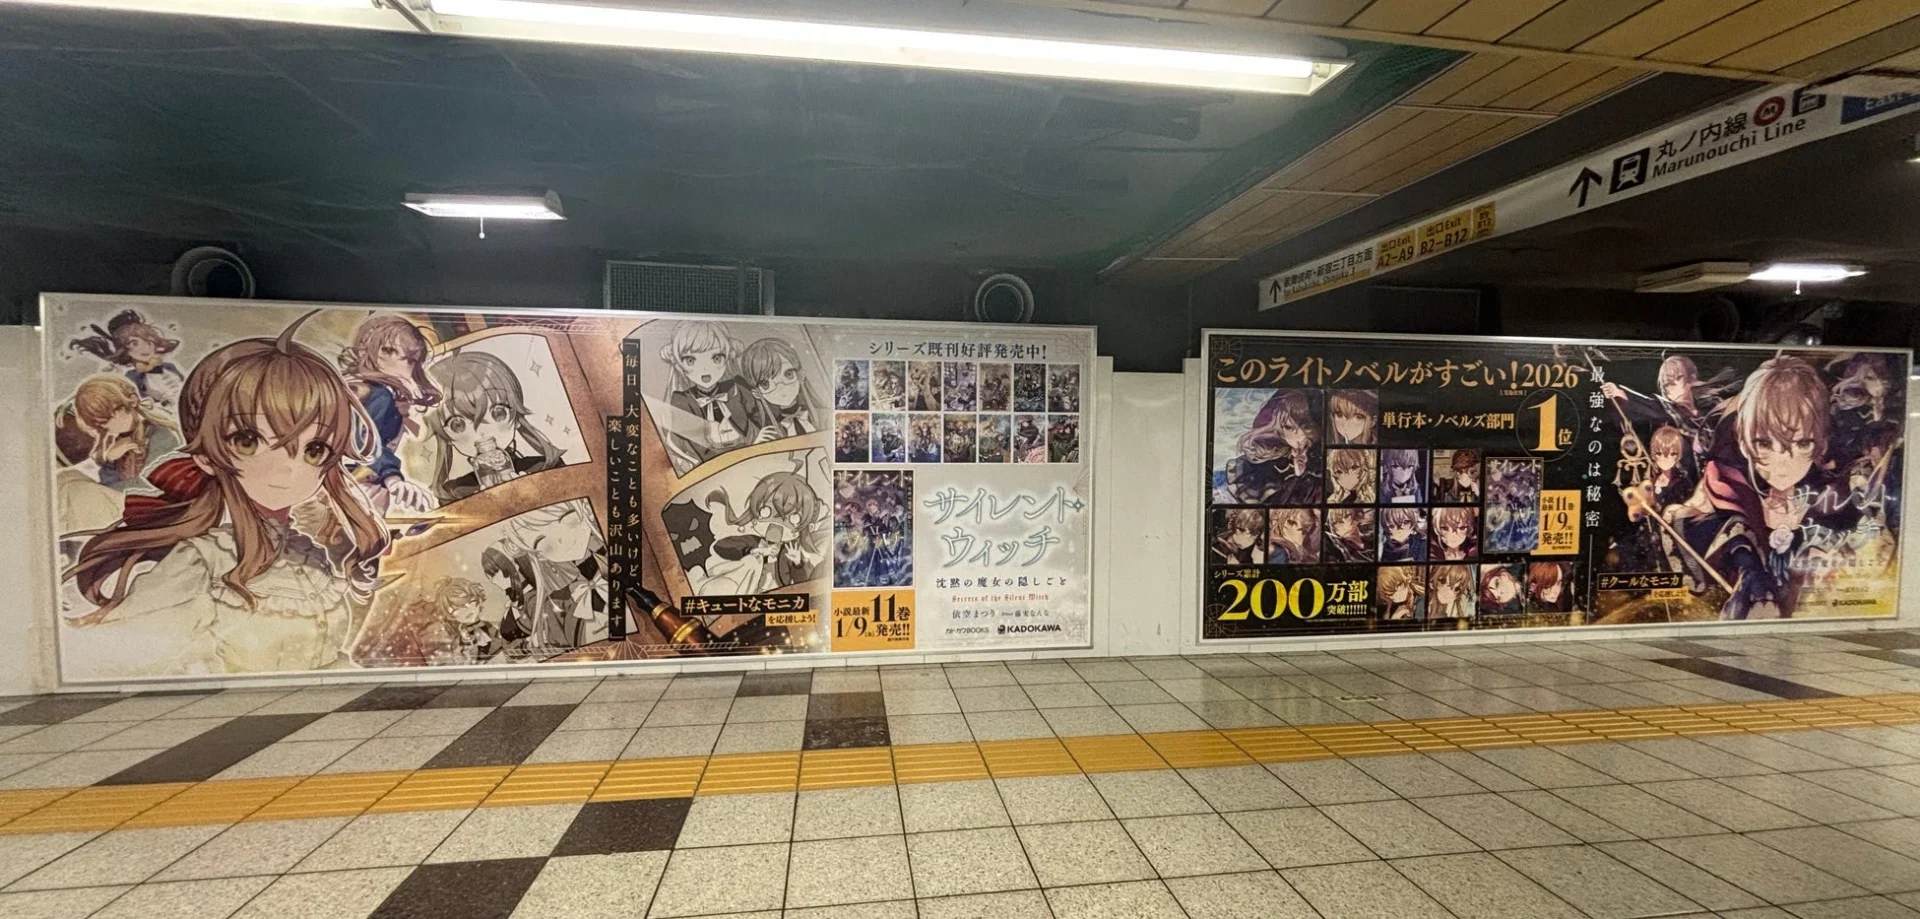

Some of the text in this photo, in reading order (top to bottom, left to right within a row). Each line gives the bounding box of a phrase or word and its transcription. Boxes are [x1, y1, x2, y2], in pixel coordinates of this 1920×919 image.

[1655, 112, 1748, 162] 丸ノ内線
[1652, 118, 1806, 178] Marunouchi Line
[1426, 217, 1461, 237] 出口 Exit
[869, 341, 1047, 360] シリーズ既刊好評発売中!
[1382, 411, 1515, 429] 単行本・ノベルズ部門
[923, 486, 1076, 525] サイレント
[608, 418, 624, 639] 楽しいことも沢山あります」
[941, 526, 1060, 568] ウィッチ
[936, 576, 1067, 589] 沈黙の魔女の隠しごと
[1601, 575, 1680, 588] #クールなモニカ
[684, 596, 806, 614] #キュートなモニカ
[1007, 624, 1062, 633] KADOKAWA
